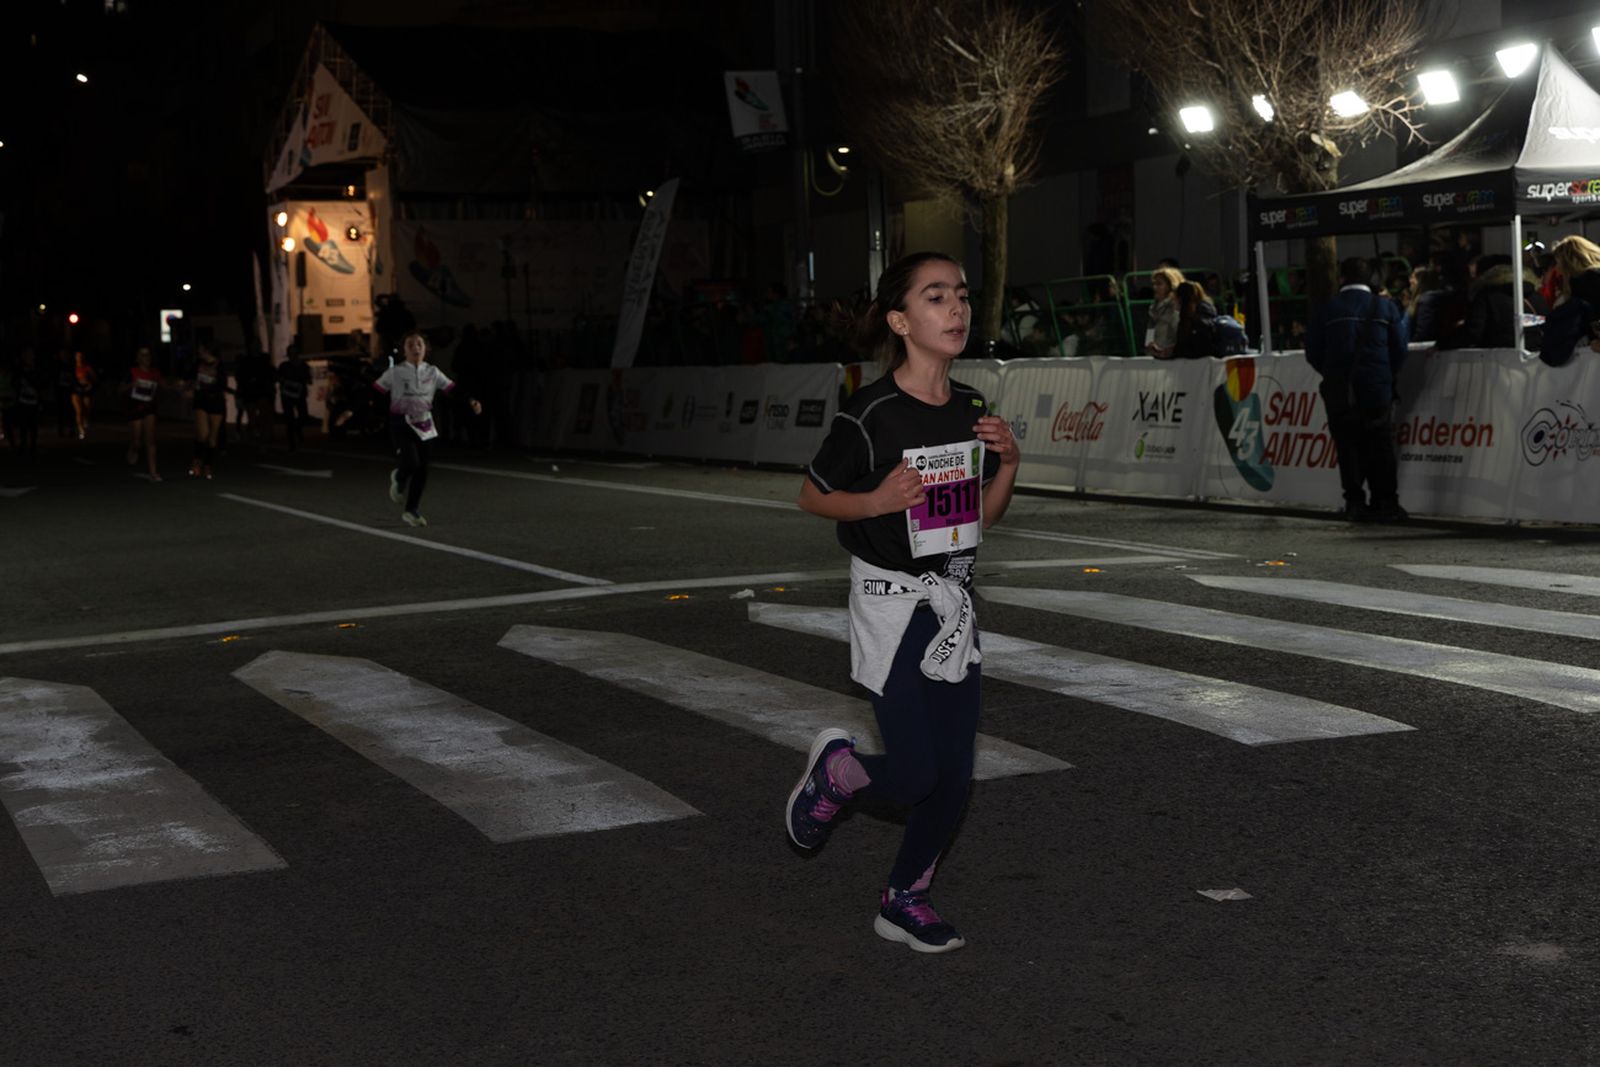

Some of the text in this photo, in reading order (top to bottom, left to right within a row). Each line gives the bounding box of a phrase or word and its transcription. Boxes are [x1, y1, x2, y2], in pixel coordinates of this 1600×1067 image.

[1132, 391, 1187, 423] XAVE
[1265, 391, 1317, 427] SAN
[1227, 406, 1261, 461] 43
[928, 456, 954, 471] NOCHE
[955, 455, 965, 467] DE
[938, 467, 966, 483] ANTÓN
